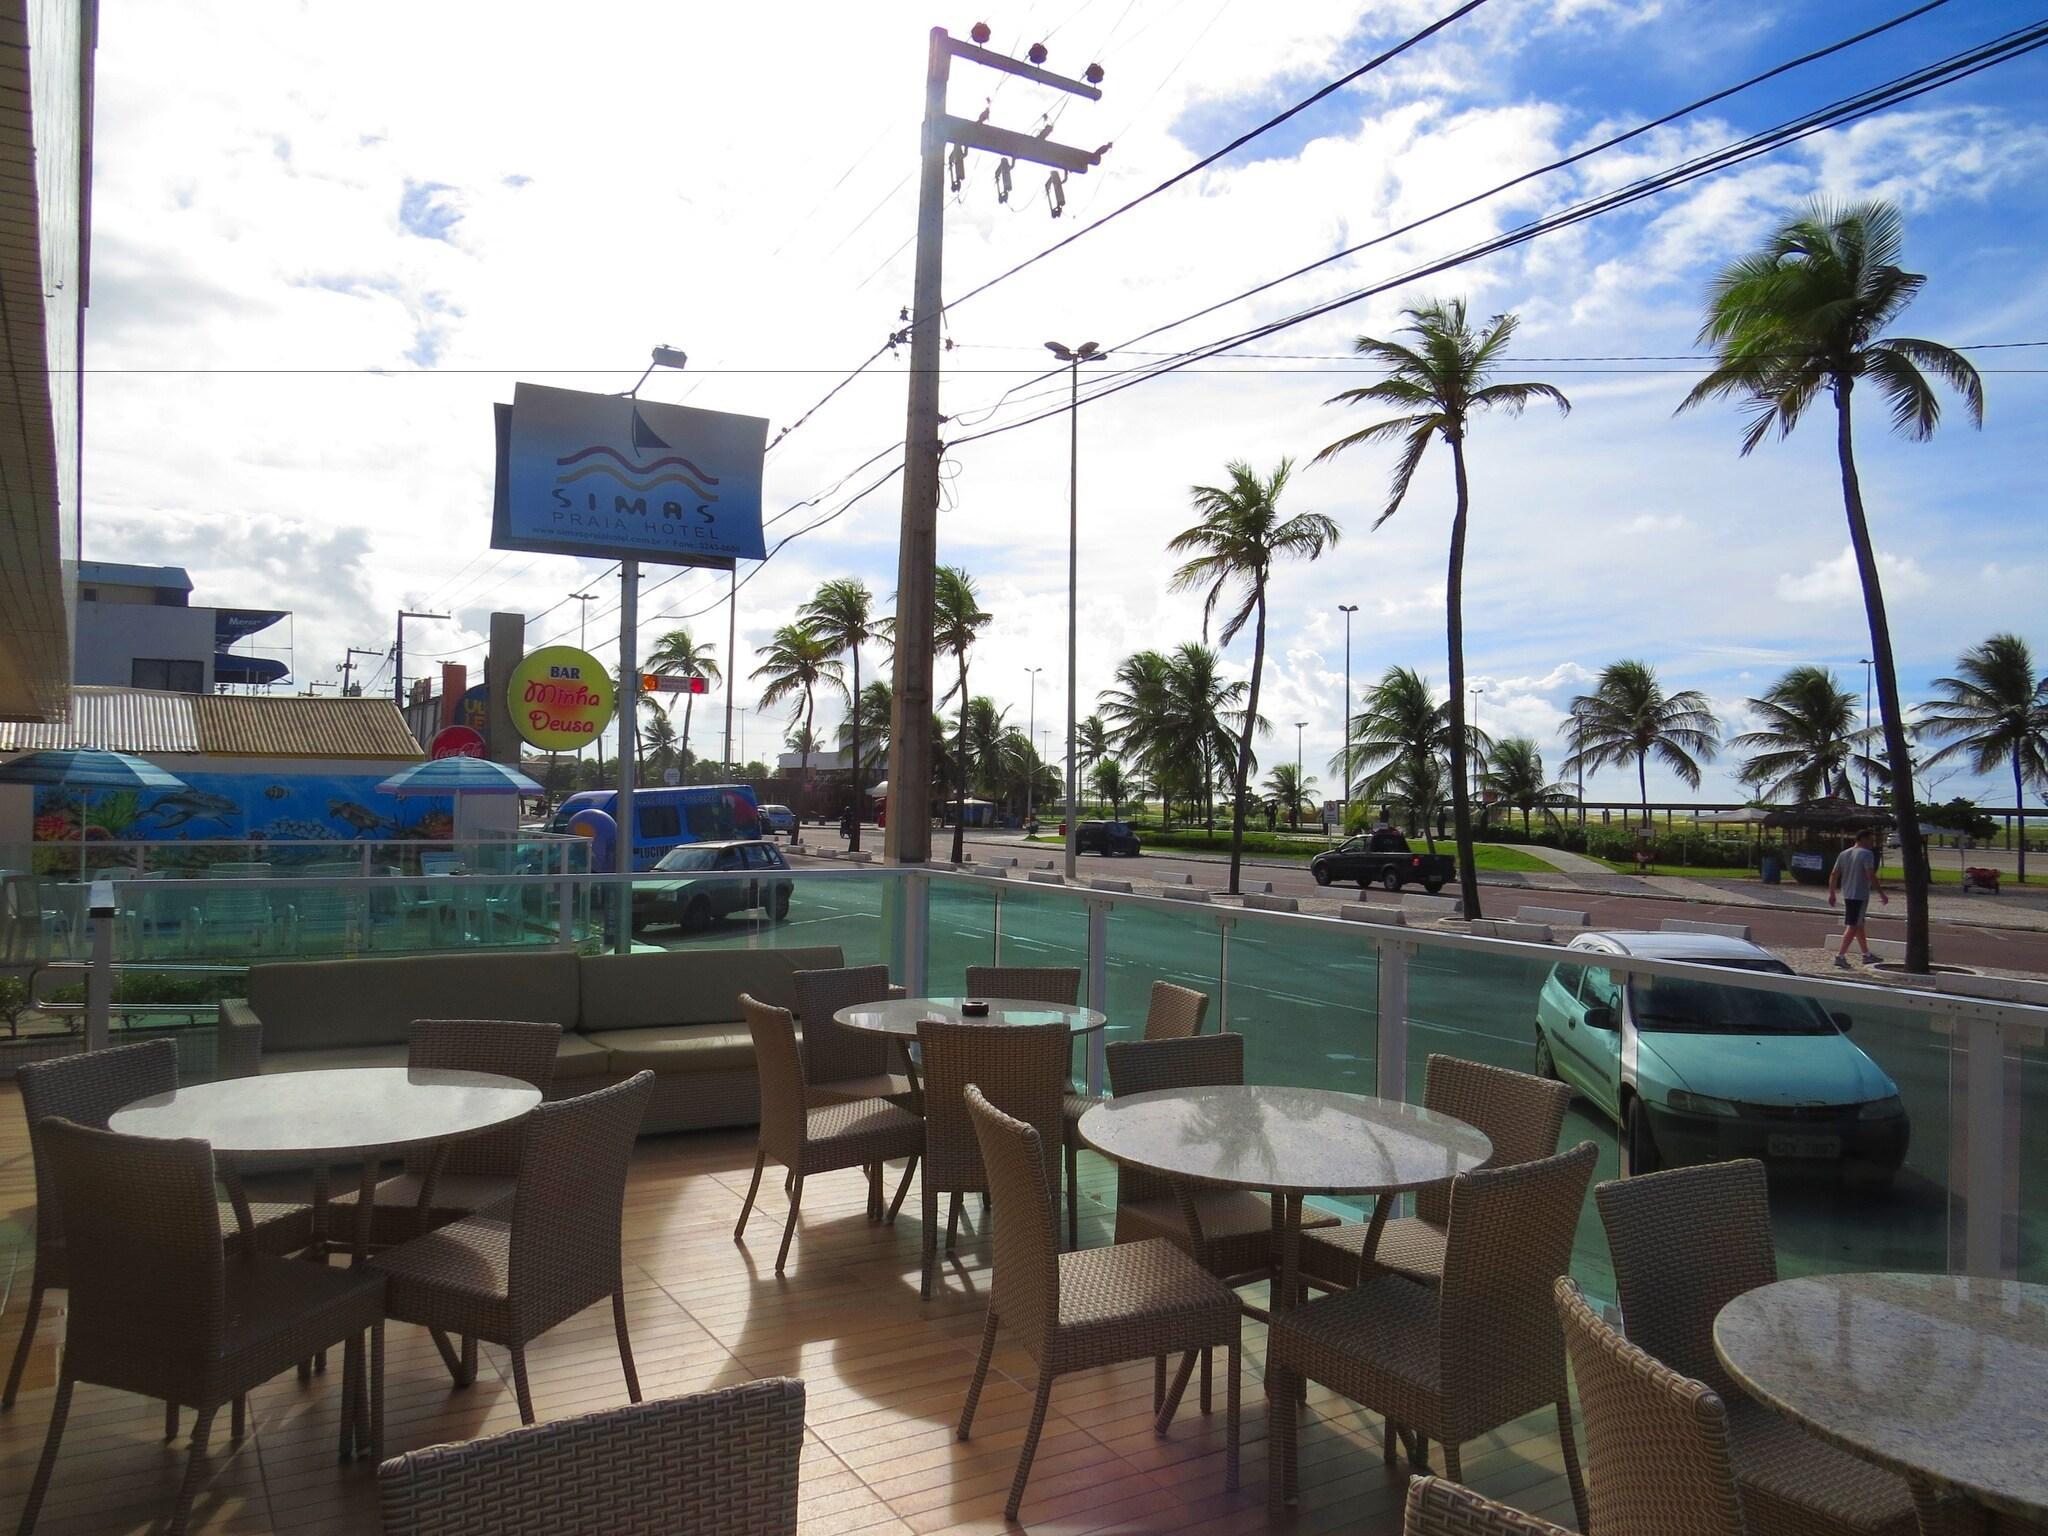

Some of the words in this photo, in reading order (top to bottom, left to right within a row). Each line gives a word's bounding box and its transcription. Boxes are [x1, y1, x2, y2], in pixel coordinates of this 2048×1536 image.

[551, 488, 715, 524] SIMAS
[552, 511, 627, 530] PRAIA
[644, 520, 719, 540] HOTEL
[550, 666, 580, 679] BAR
[524, 680, 600, 706] Minha
[529, 710, 594, 733] Deusa
